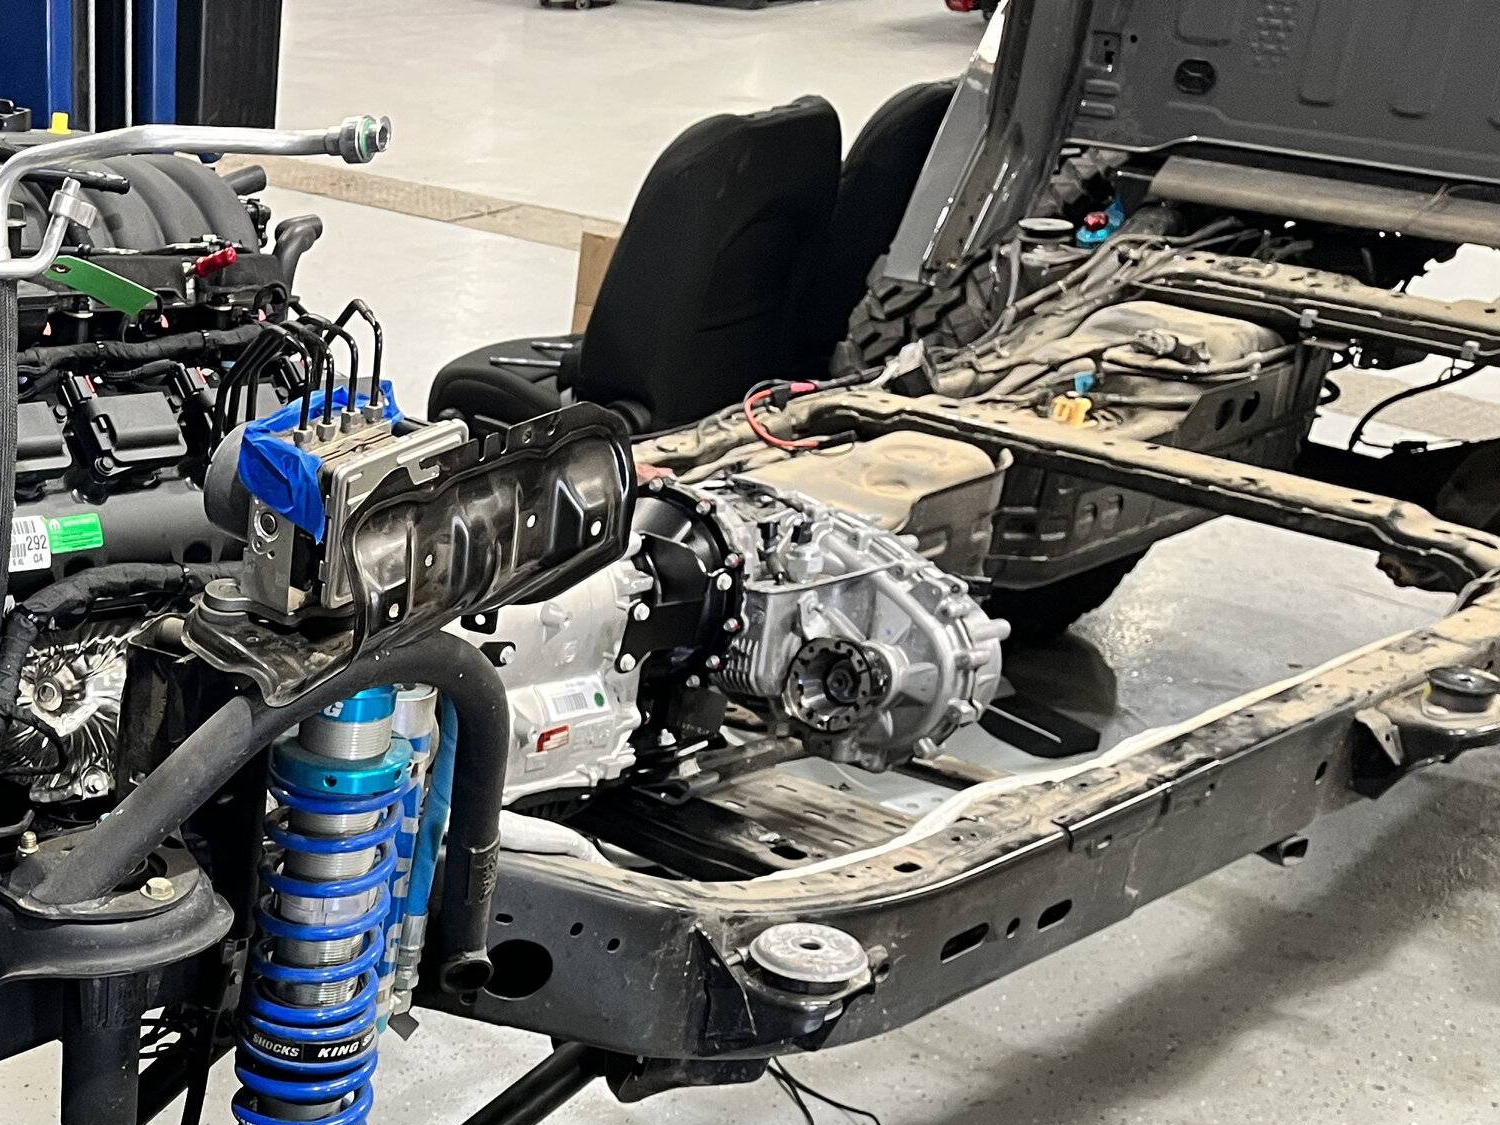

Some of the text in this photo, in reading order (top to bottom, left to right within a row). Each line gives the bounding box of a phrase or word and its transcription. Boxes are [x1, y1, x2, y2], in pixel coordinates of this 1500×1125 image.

[25, 534, 48, 551] 292
[252, 1033, 300, 1057] SHOCKS
[317, 1041, 360, 1058] KING
